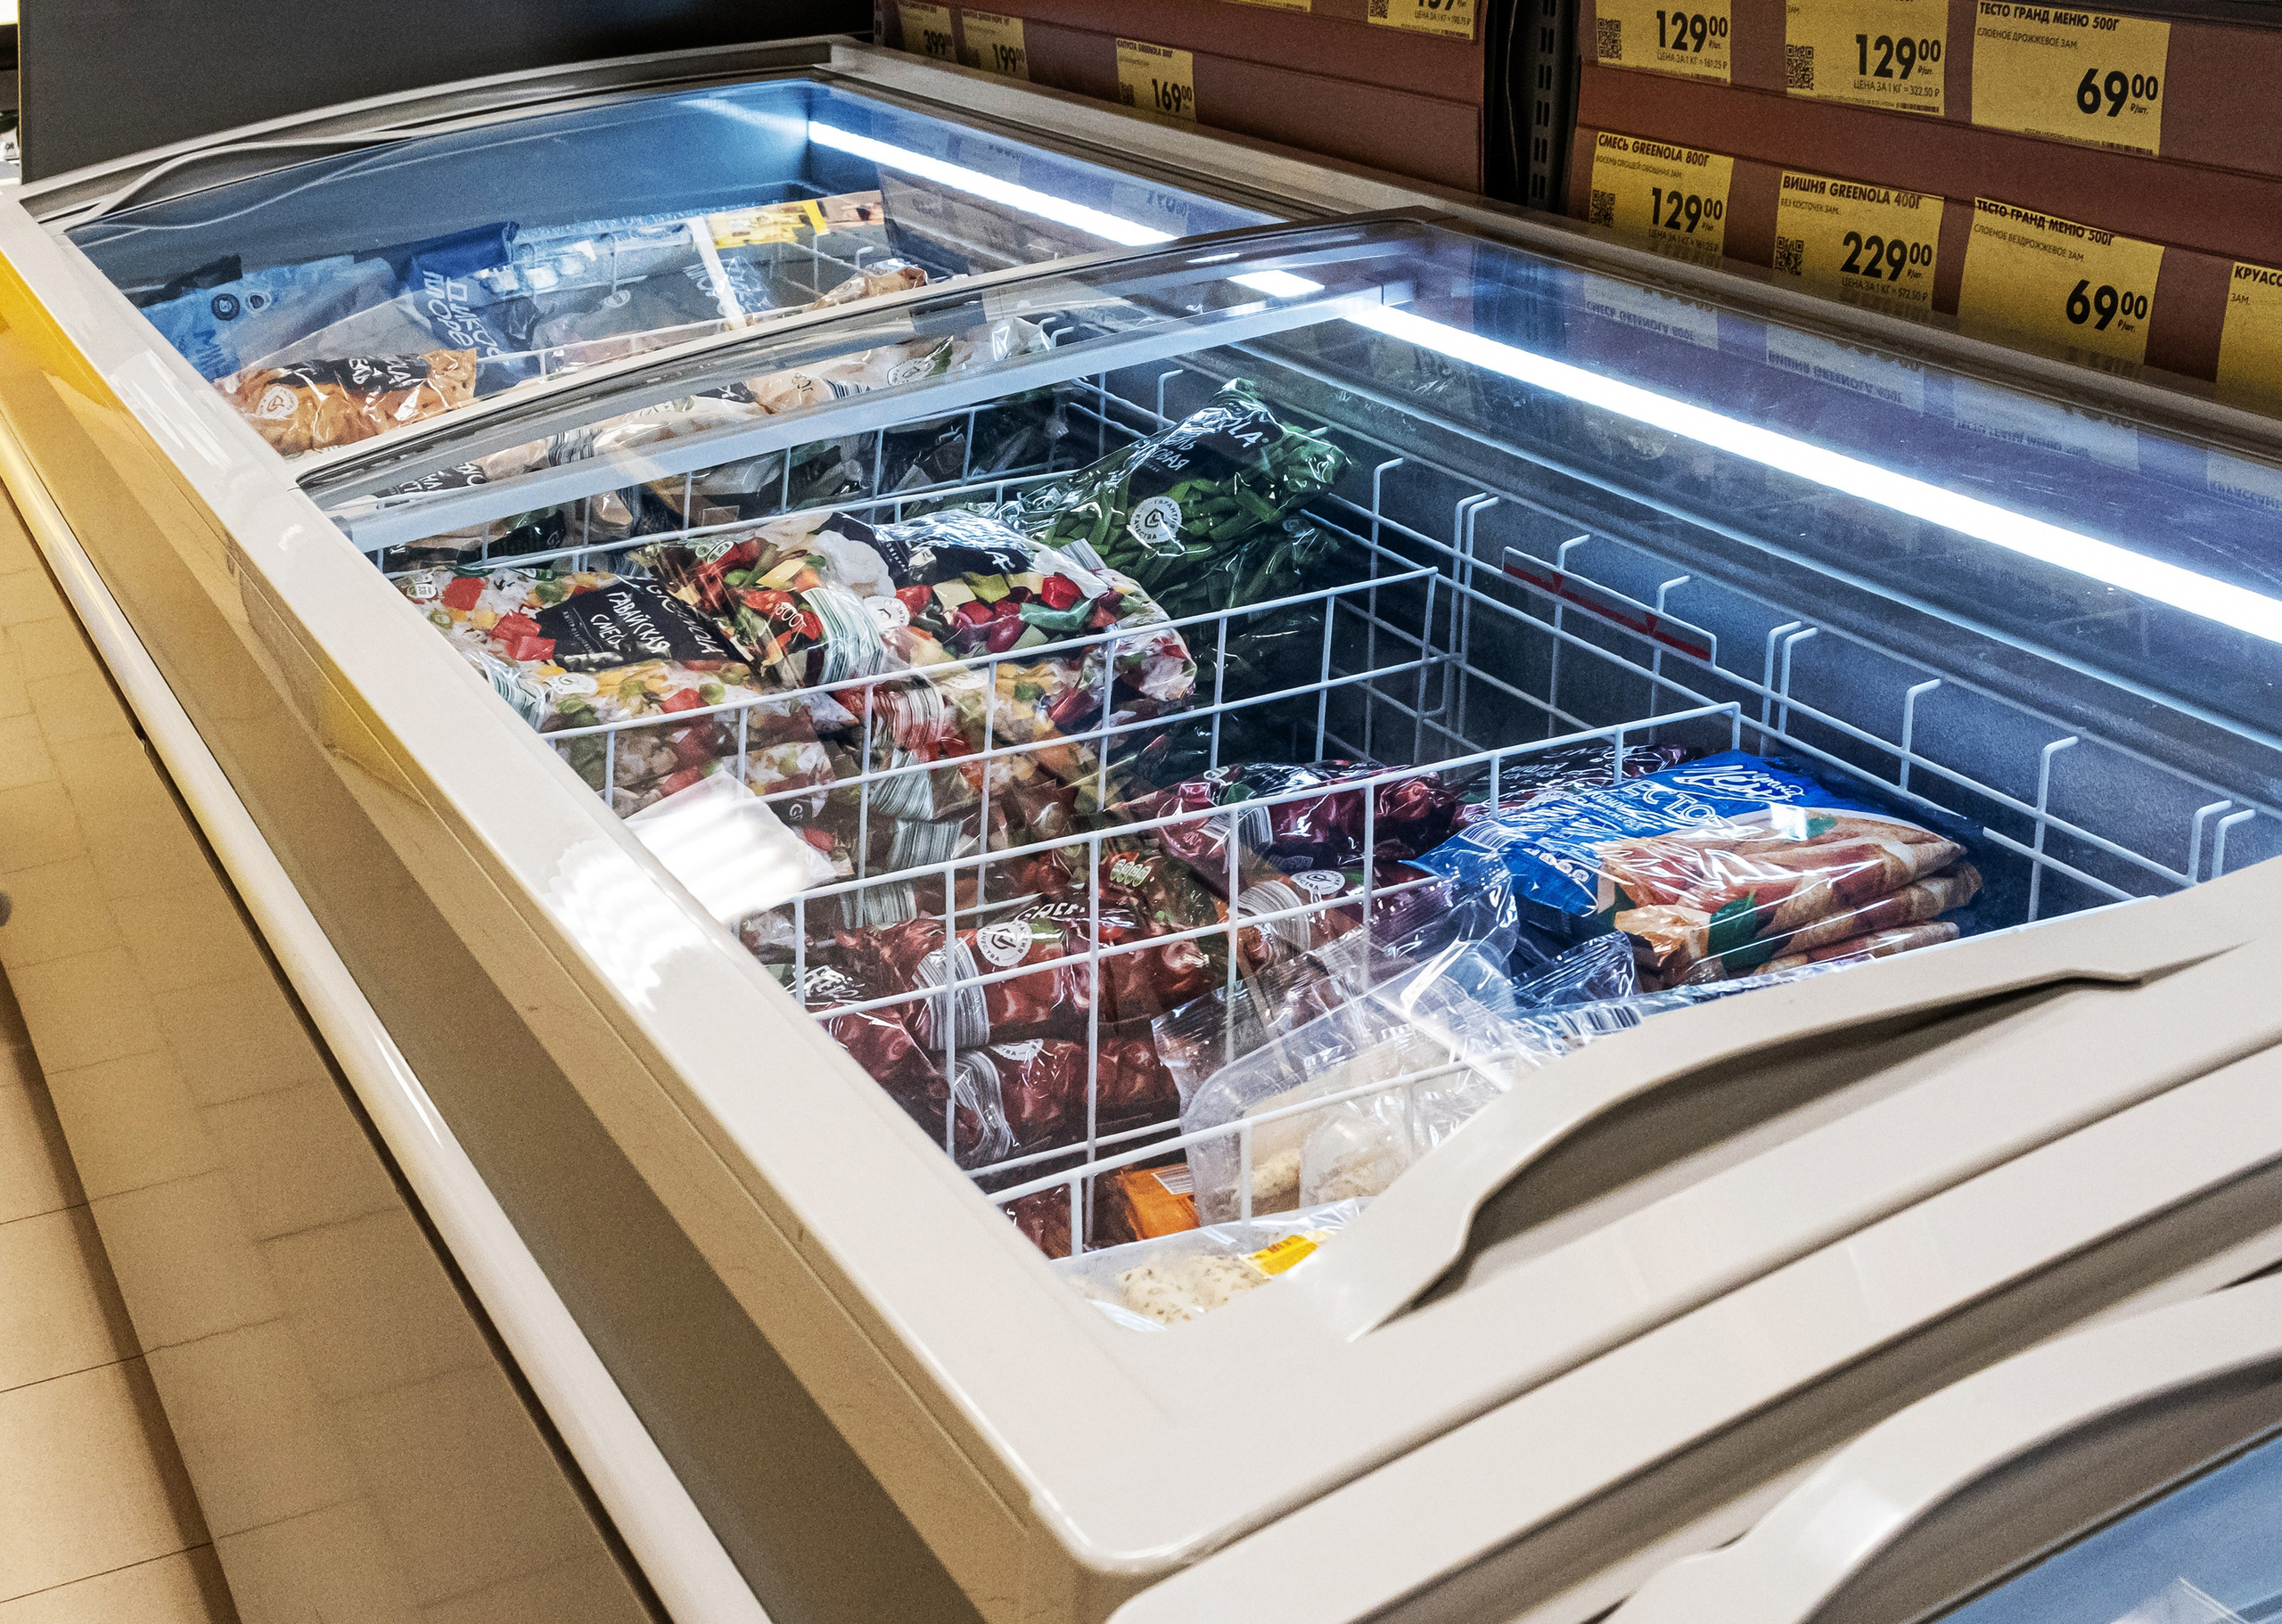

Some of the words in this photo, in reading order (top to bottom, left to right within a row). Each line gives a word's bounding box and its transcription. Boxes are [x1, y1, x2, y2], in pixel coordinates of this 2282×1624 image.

[1656, 11, 1707, 53] 129
[1709, 16, 1728, 37] 00
[1979, 3, 2010, 18] ТЕСТО
[2014, 8, 2050, 24] ГРАНД
[2053, 12, 2089, 28] МЕНЮ
[2092, 16, 2120, 31] 500Г
[1856, 34, 1917, 79] 129
[1918, 38, 1941, 62] 00
[1977, 28, 2011, 41] СЛОЕНОЕ
[2013, 32, 2059, 47] ДРОЖЖЕВОЕ
[992, 43, 1016, 71] 199
[1152, 78, 1181, 111] 169
[1853, 79, 1875, 91] ЦЕНА
[1876, 82, 1886, 92] ЗА
[1892, 83, 1902, 94] КГ
[2077, 68, 2129, 118] 69
[2131, 74, 2158, 101] 00
[1598, 135, 1629, 151] СМЕСЬ
[1632, 141, 1683, 162] GREENOLA
[1686, 151, 1711, 168] 800Г
[1652, 187, 1703, 234] 129
[1703, 198, 1723, 220] 00
[1783, 175, 1826, 194] ВИШНЯ
[1829, 183, 1891, 205] GREENOLA
[1894, 192, 1923, 209] 400Г
[1974, 224, 2007, 241] СЛОЕНОЕ
[2007, 233, 2067, 257] БЕЗДРОЖЖЕВОЕ
[1977, 199, 2007, 217] ТЕСТО
[2010, 209, 2046, 231] ГРАНД
[2048, 219, 2085, 239] МЕНЮ
[2088, 229, 2114, 246] 500Г
[1840, 231, 1908, 281] 229
[1909, 242, 1933, 267] 00
[2066, 279, 2119, 332] 69
[2121, 291, 2148, 320] 00
[606, 591, 672, 655] ГАВАЙСКАЯ
